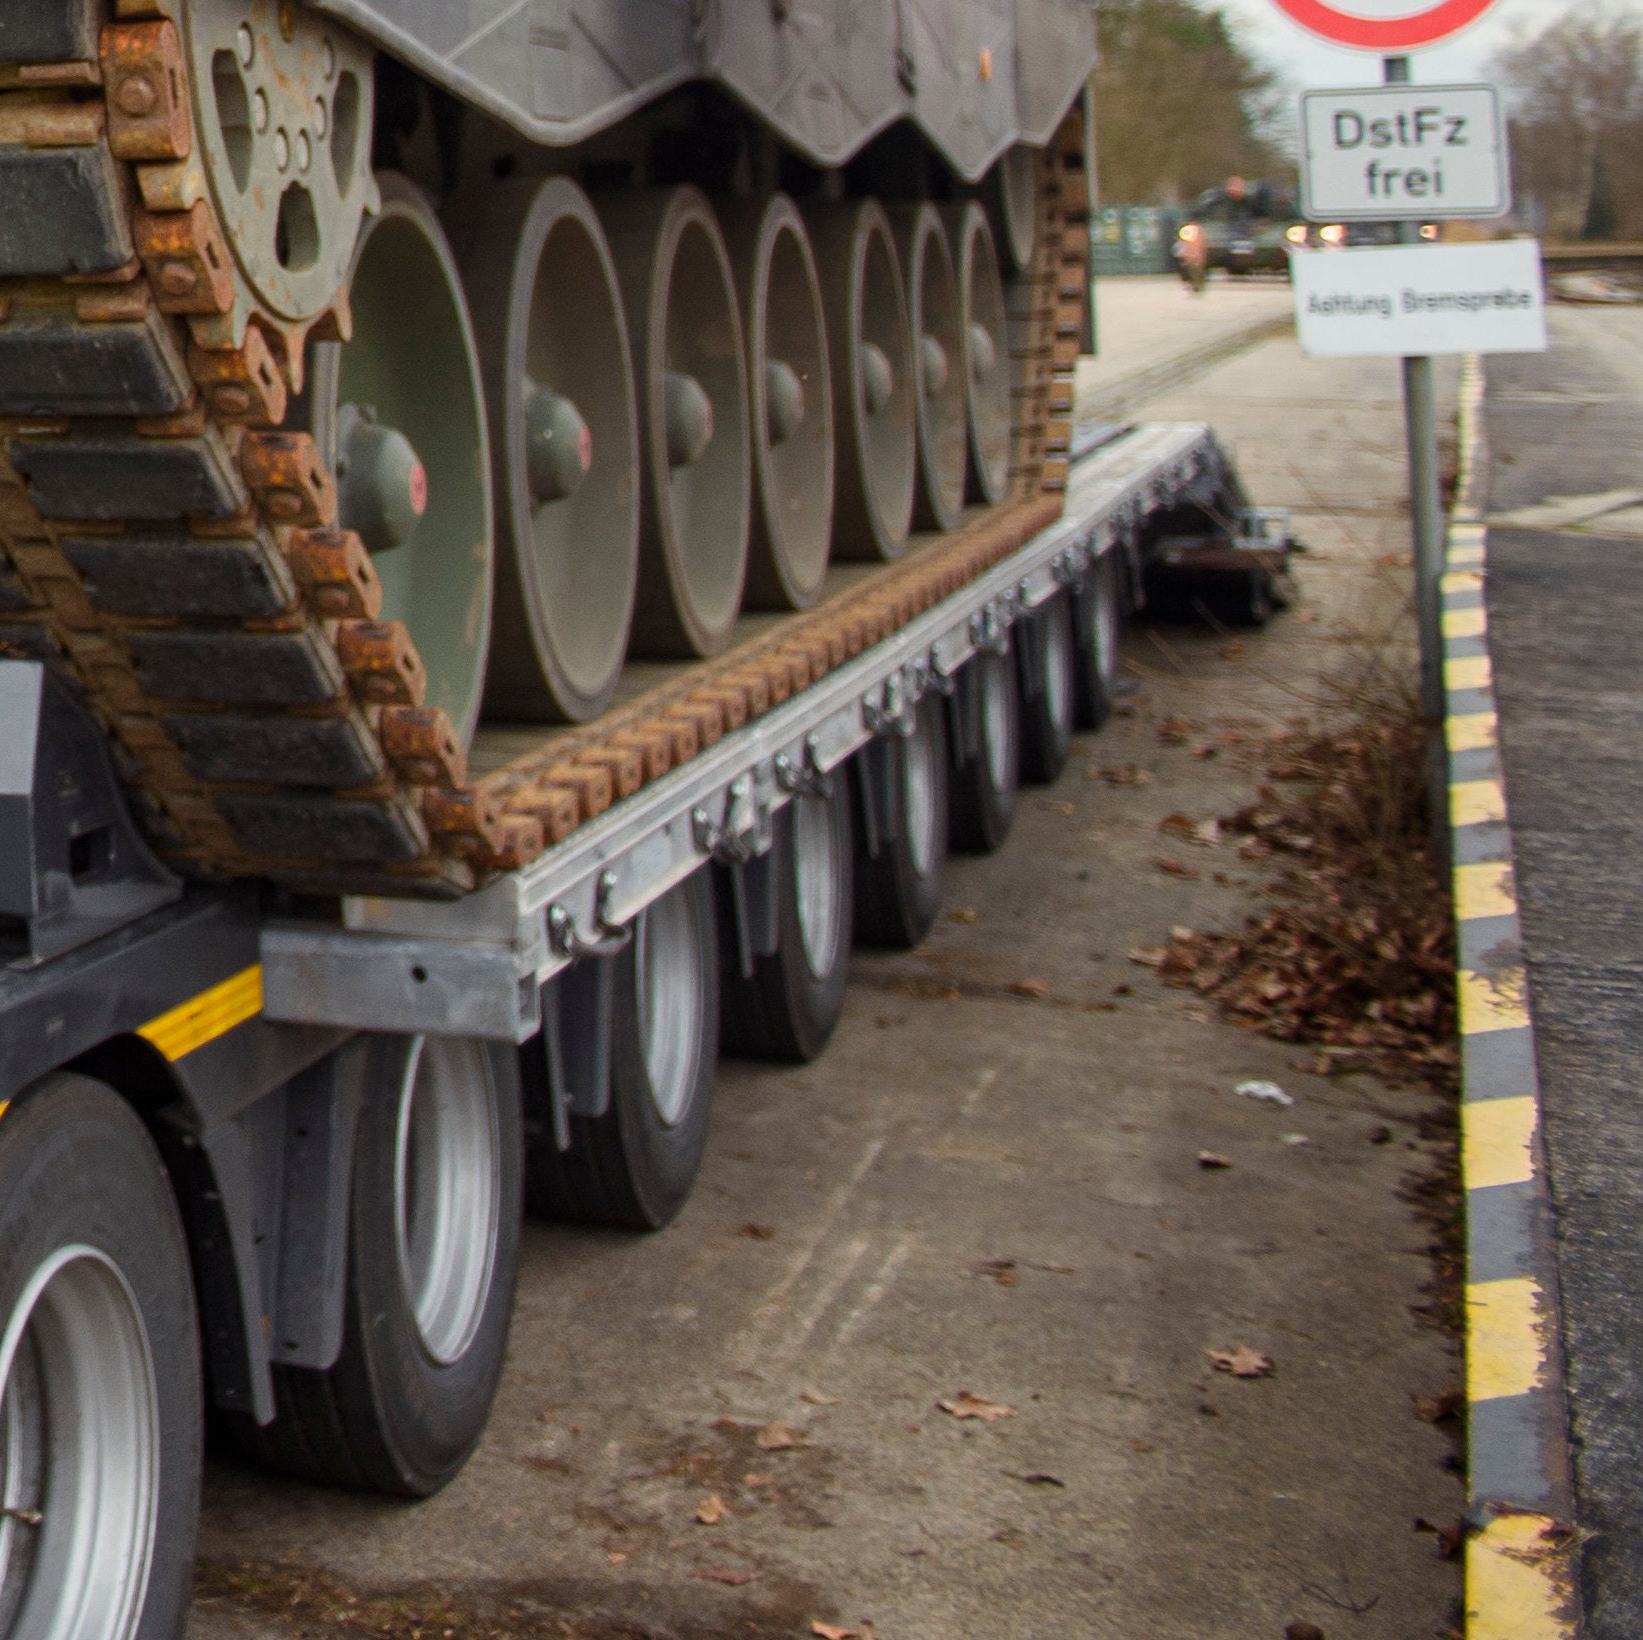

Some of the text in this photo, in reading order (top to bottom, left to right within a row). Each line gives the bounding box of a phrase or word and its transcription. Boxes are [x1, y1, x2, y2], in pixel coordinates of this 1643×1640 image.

[1333, 108, 1467, 148] DstFz
[1366, 158, 1443, 196] frei
[1308, 294, 1392, 319] Achtung
